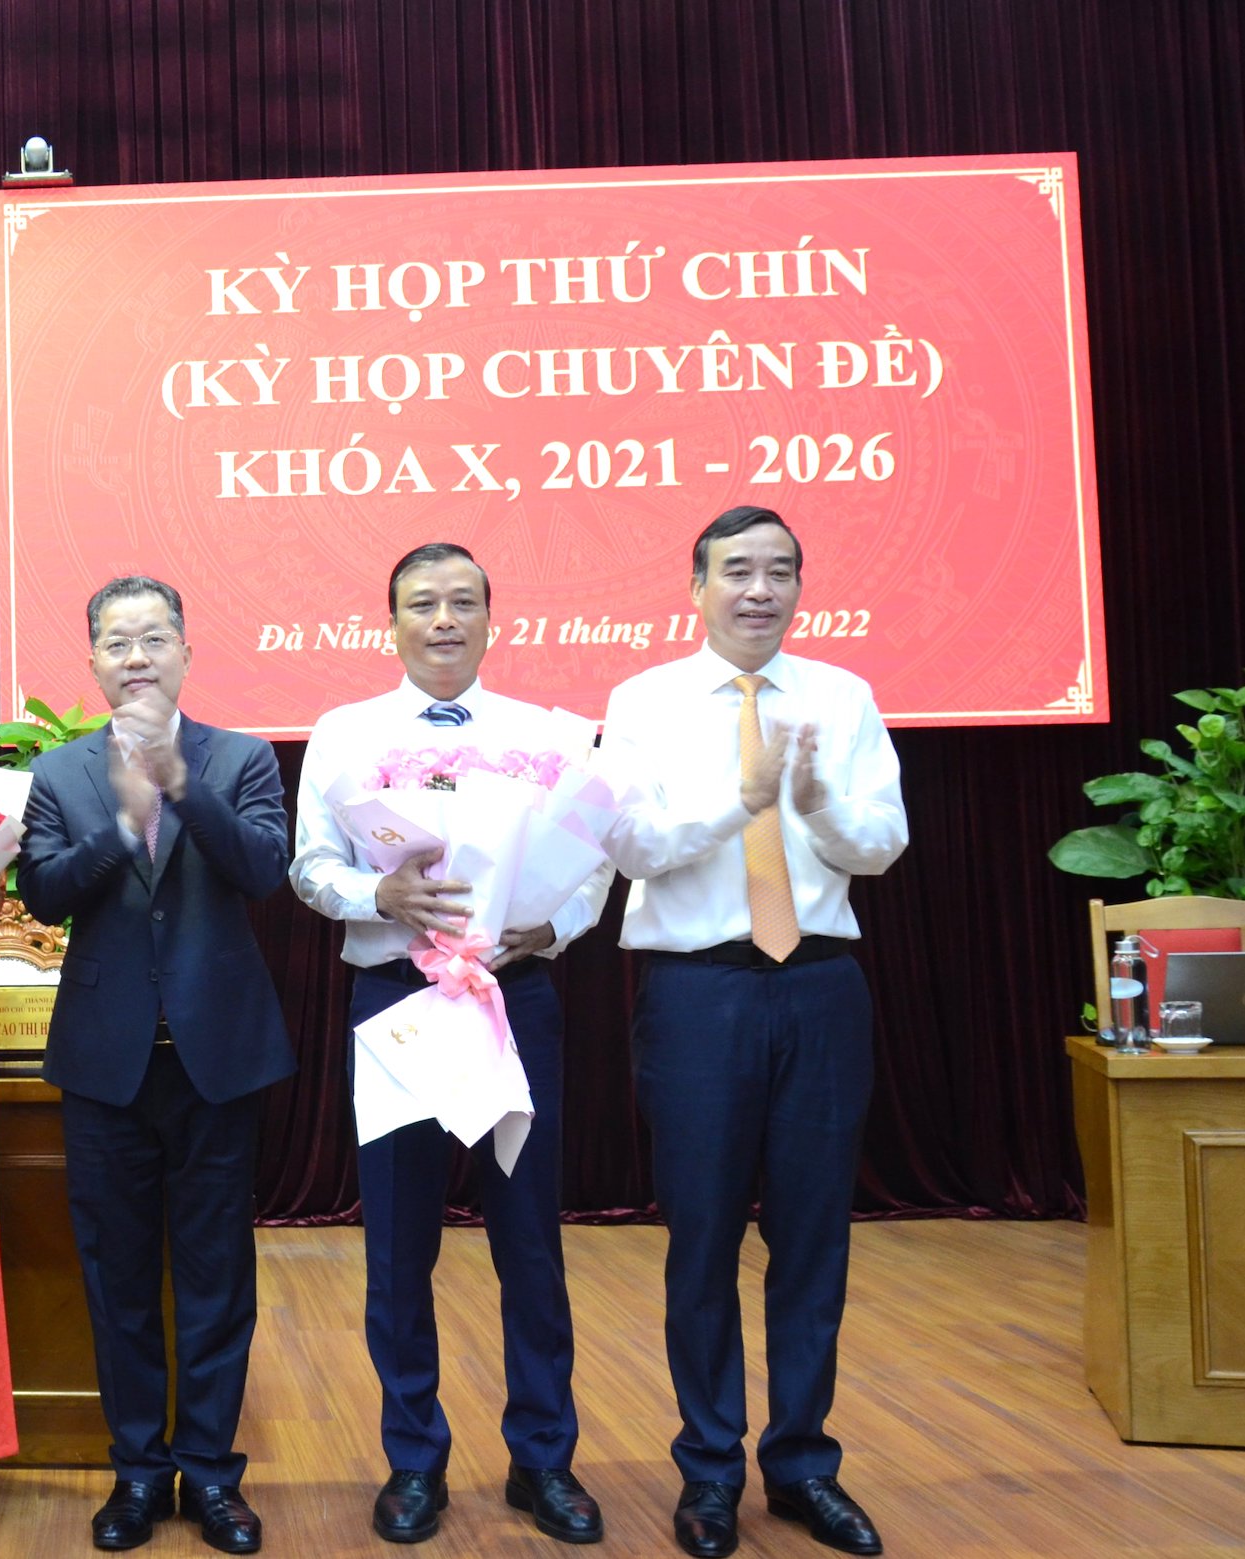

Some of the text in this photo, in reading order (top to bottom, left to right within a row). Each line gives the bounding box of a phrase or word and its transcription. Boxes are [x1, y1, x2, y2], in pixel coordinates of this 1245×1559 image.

[205, 236, 869, 322] KỲ HỌP THỨ CHÍN
[162, 325, 942, 420] (KỲ HỌP CHUYÊN ĐỀ)
[214, 433, 436, 498] KHÓA
[451, 444, 520, 501] X,
[541, 439, 681, 489] 2021
[749, 433, 894, 483] 2026
[257, 623, 304, 651] Đà
[314, 615, 399, 656] Nẵng
[510, 618, 547, 644] 21
[559, 616, 653, 650] tháng
[665, 614, 697, 641] 11
[791, 610, 871, 638] 2022
[19, 1022, 37, 1038] THỊ
